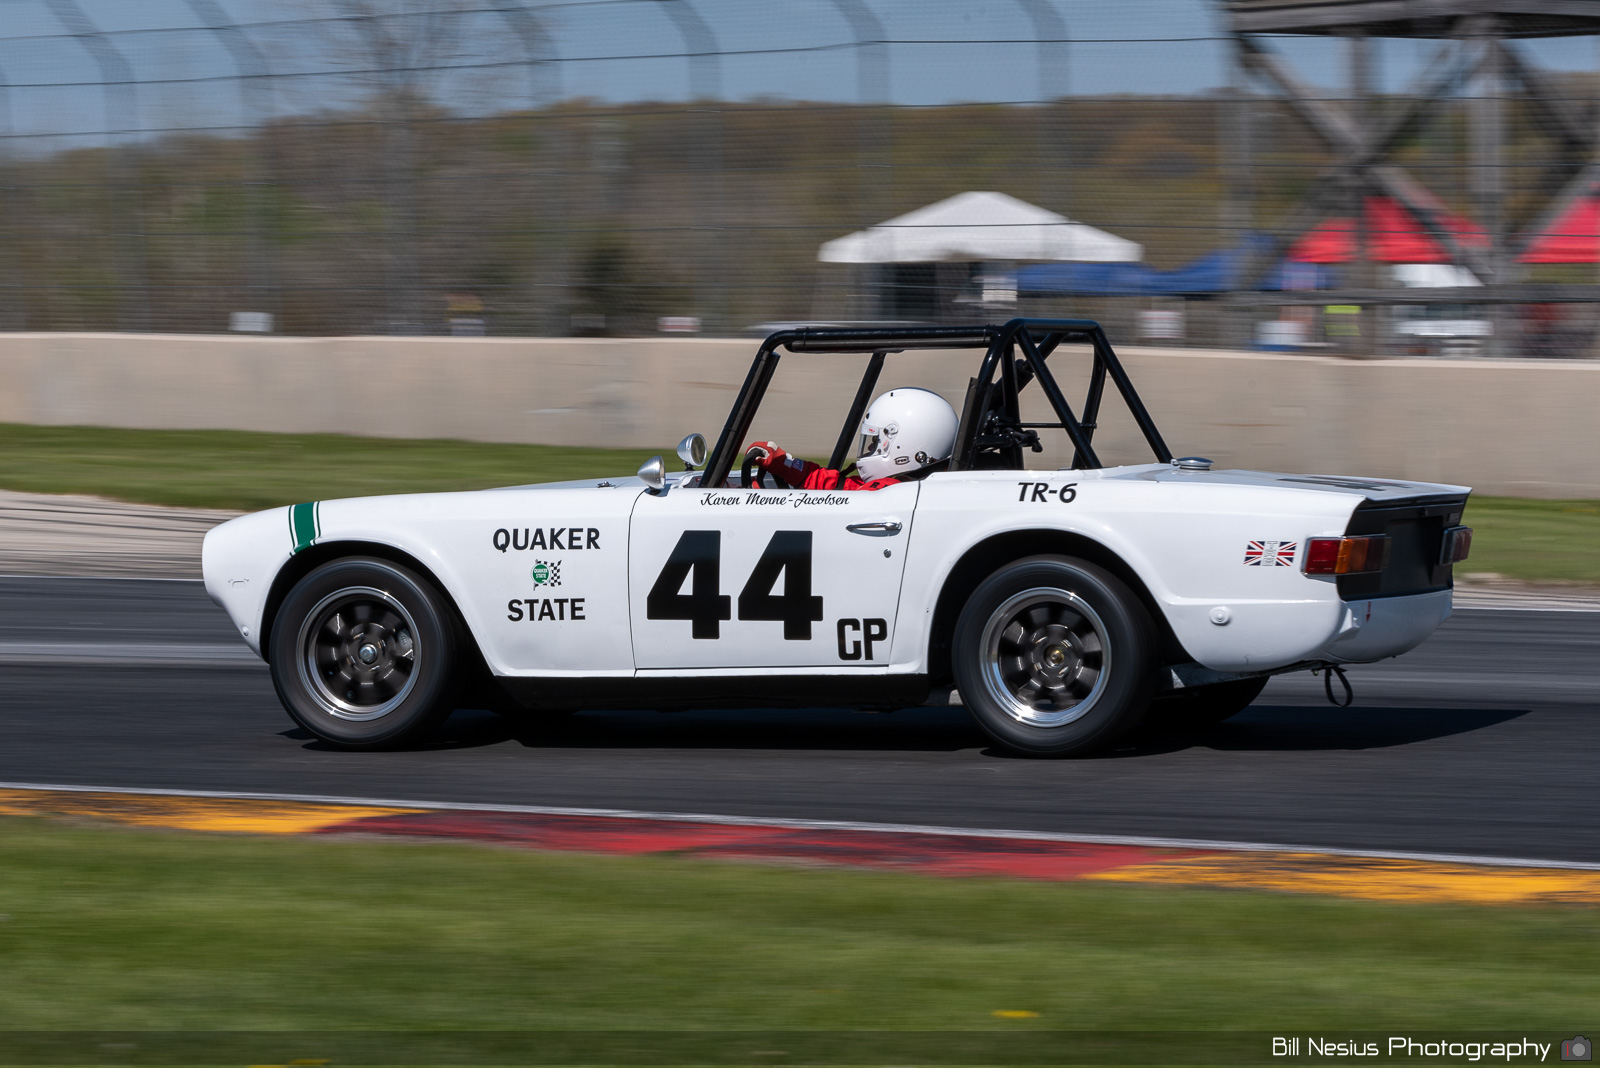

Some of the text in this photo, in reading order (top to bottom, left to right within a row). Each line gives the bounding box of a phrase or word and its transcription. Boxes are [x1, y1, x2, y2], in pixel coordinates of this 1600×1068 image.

[700, 493, 741, 506] Karen
[1018, 482, 1078, 503] TR-6
[492, 528, 601, 553] QUAKER
[646, 530, 824, 640] 44
[507, 598, 586, 622] STATE
[836, 618, 888, 661] CP
